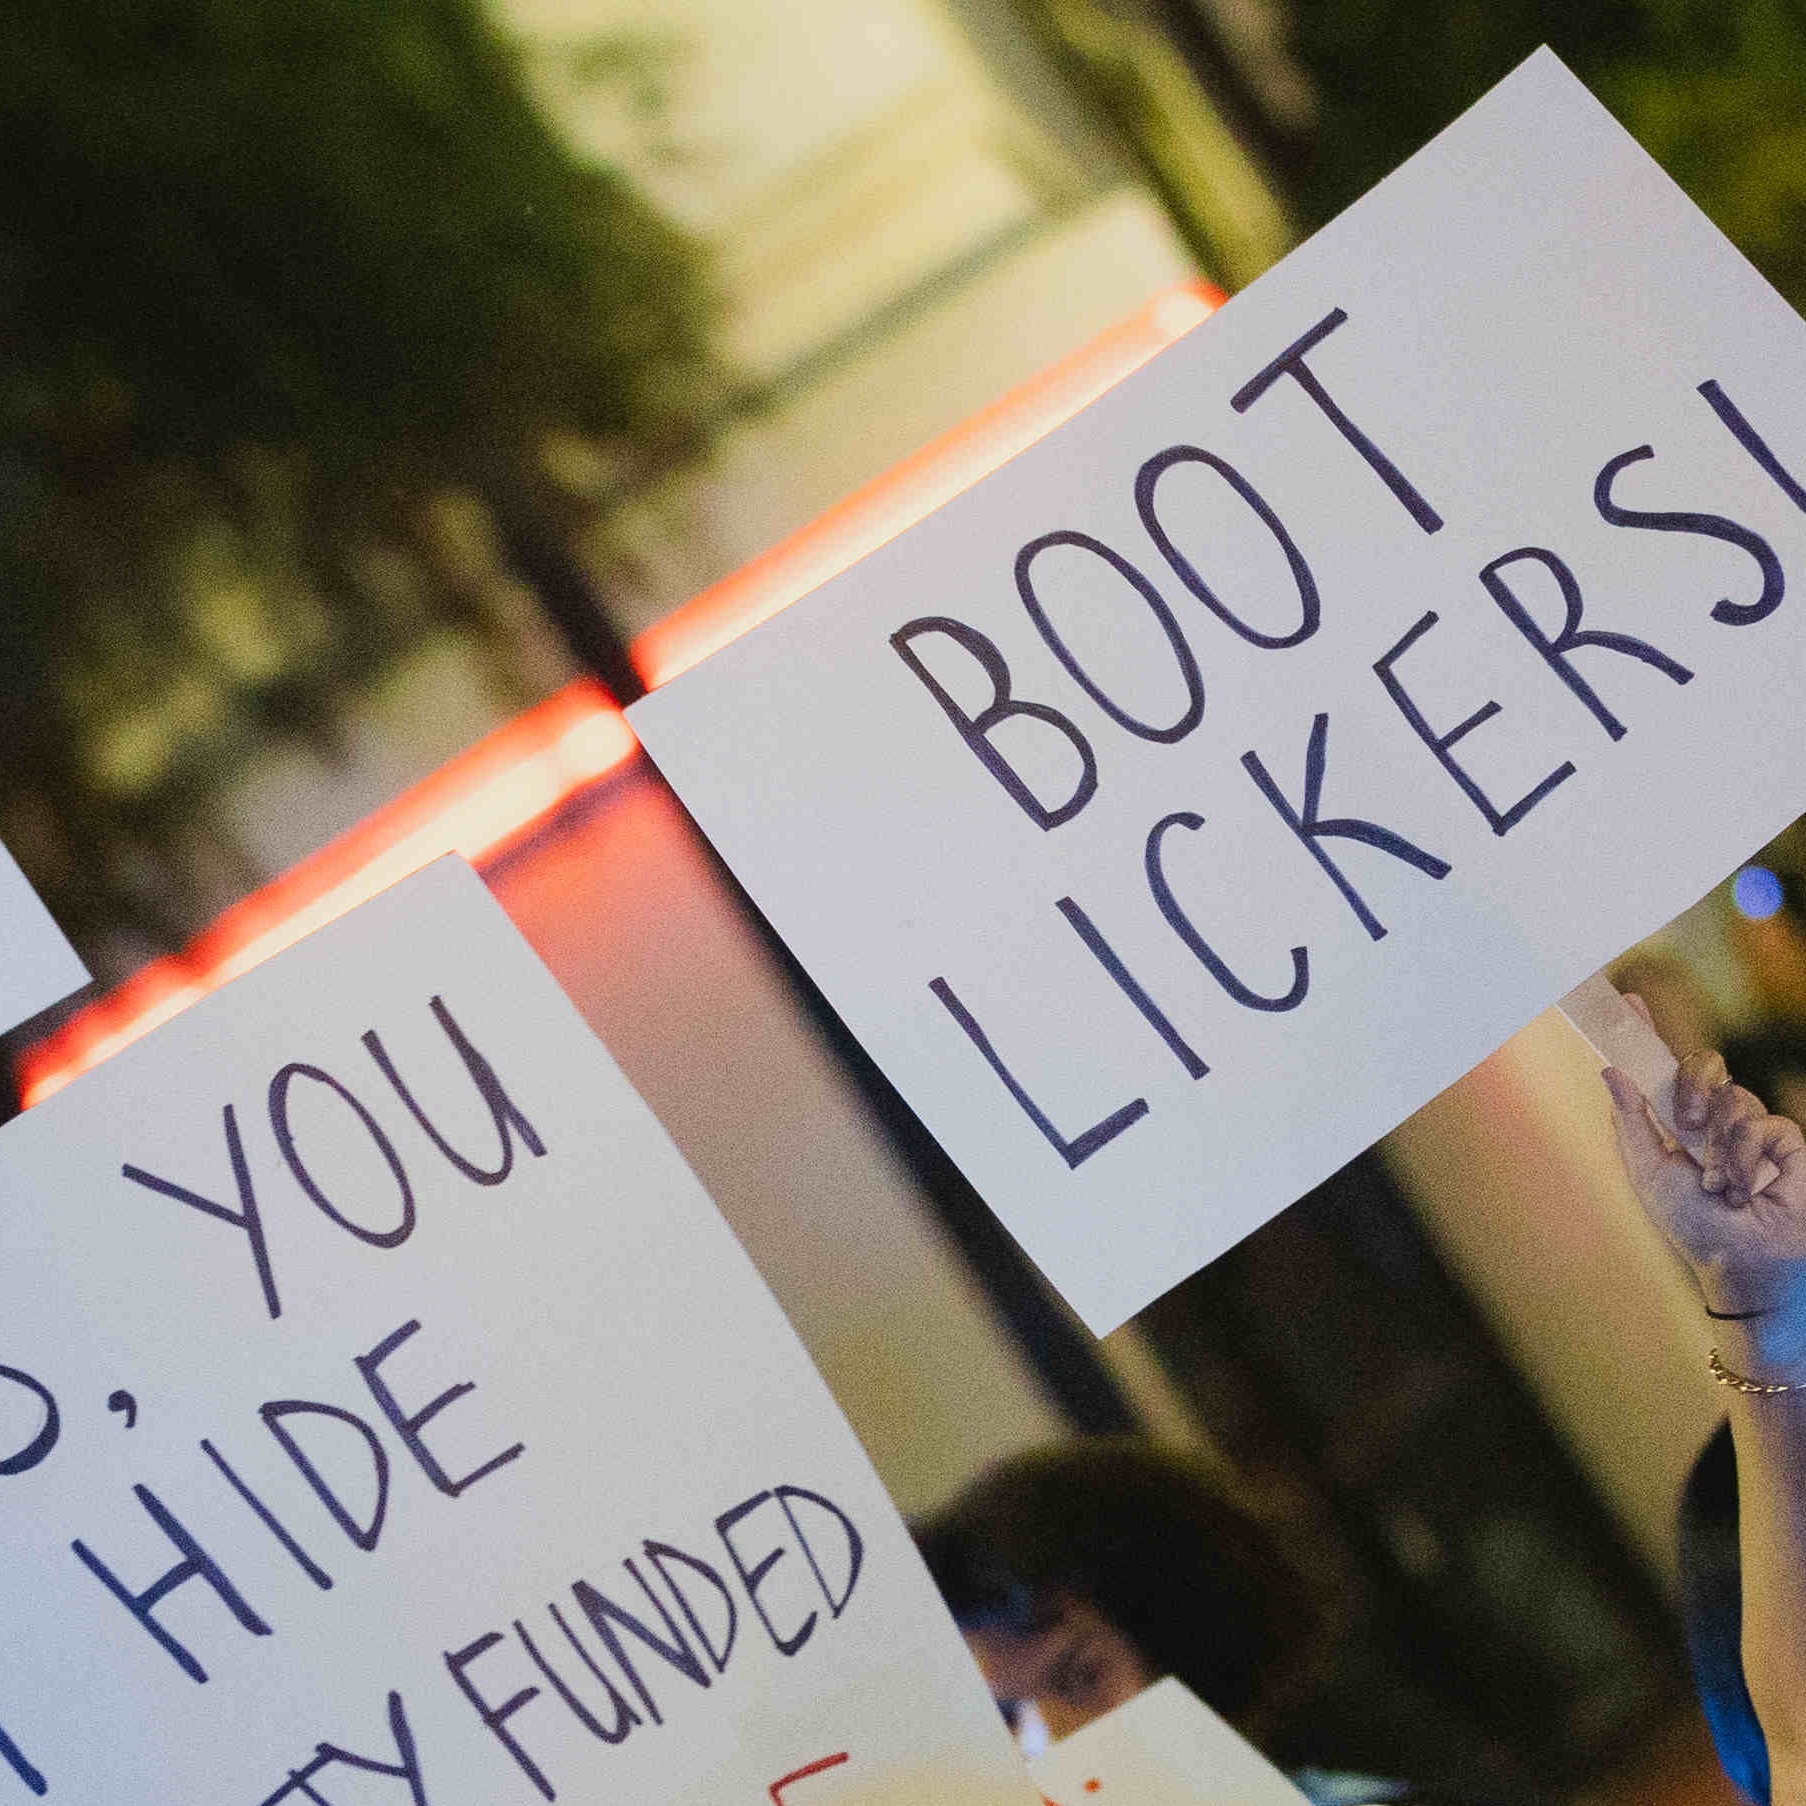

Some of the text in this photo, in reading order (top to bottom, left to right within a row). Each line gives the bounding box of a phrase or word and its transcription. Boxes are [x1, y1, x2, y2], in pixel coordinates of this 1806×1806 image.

[888, 307, 1445, 833] BOOT
[120, 994, 548, 1321] YOU
[69, 1318, 527, 1686] HIDE
[442, 1483, 864, 1804] FUNDED
